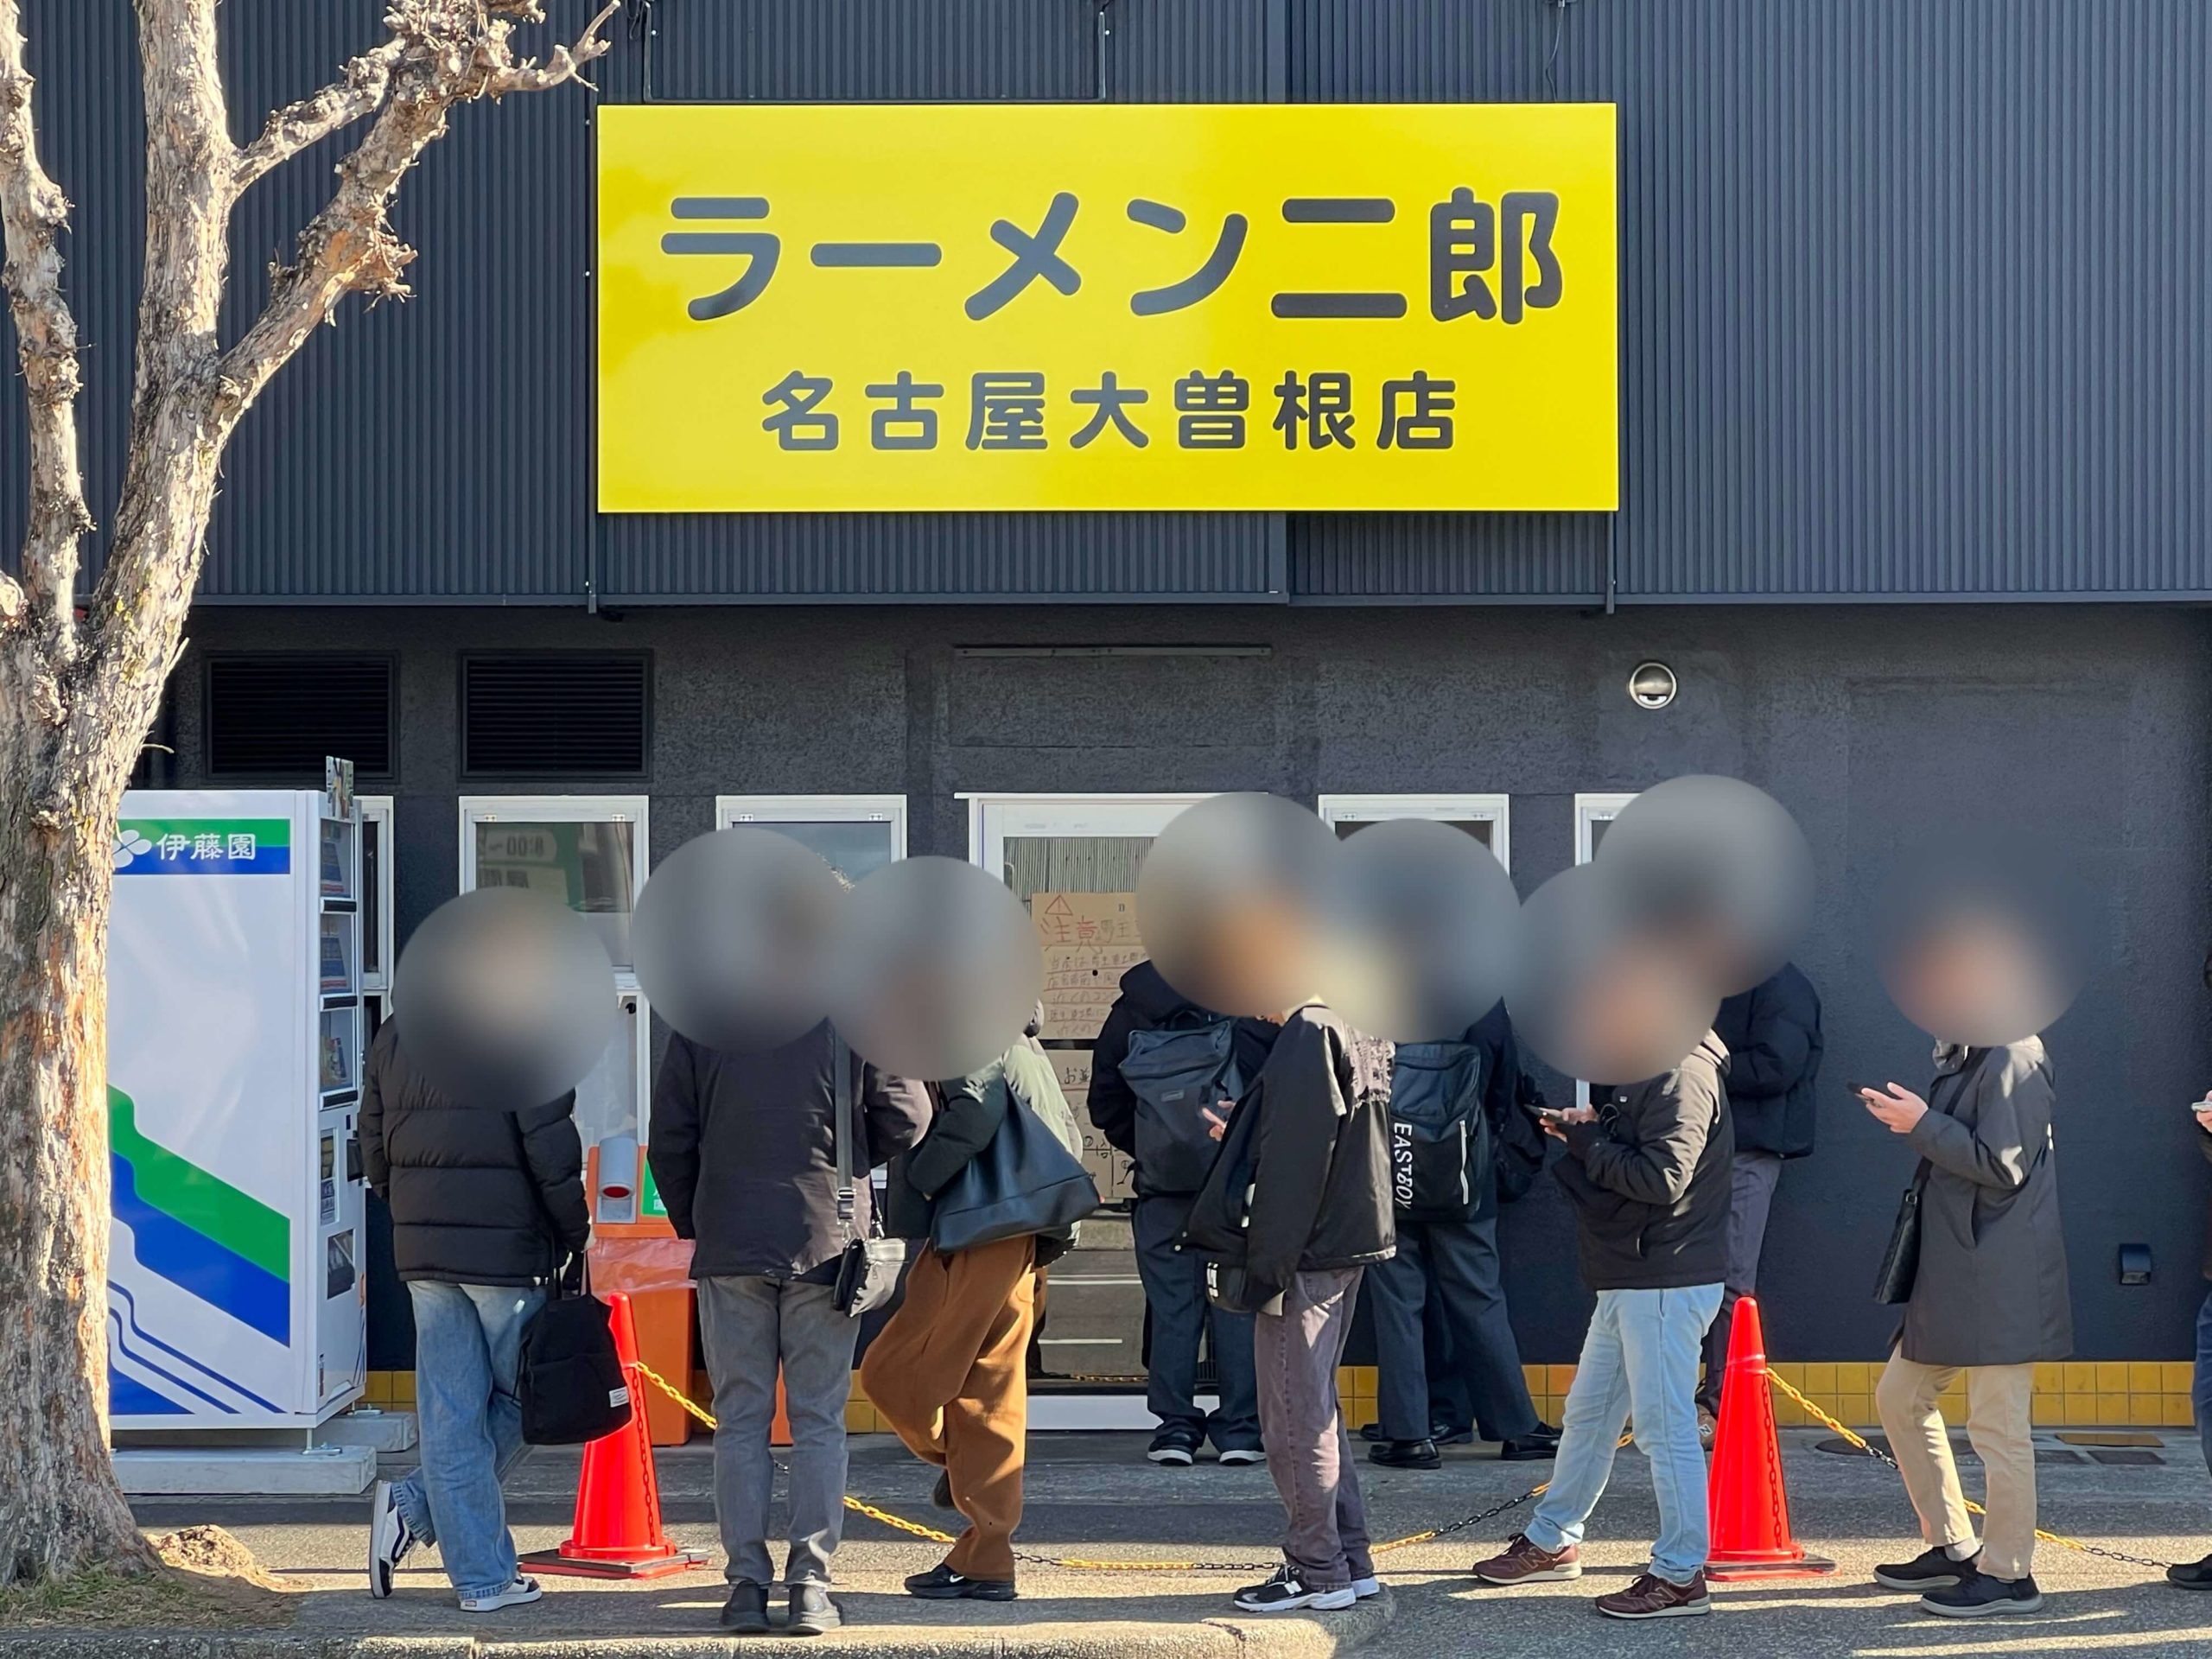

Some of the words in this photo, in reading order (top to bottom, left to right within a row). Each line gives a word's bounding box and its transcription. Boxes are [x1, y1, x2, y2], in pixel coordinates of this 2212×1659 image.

[661, 188, 1561, 323] ラーメン二郎
[762, 371, 1454, 451] 名古屋大曽根店
[156, 833, 256, 861] 伊藤園
